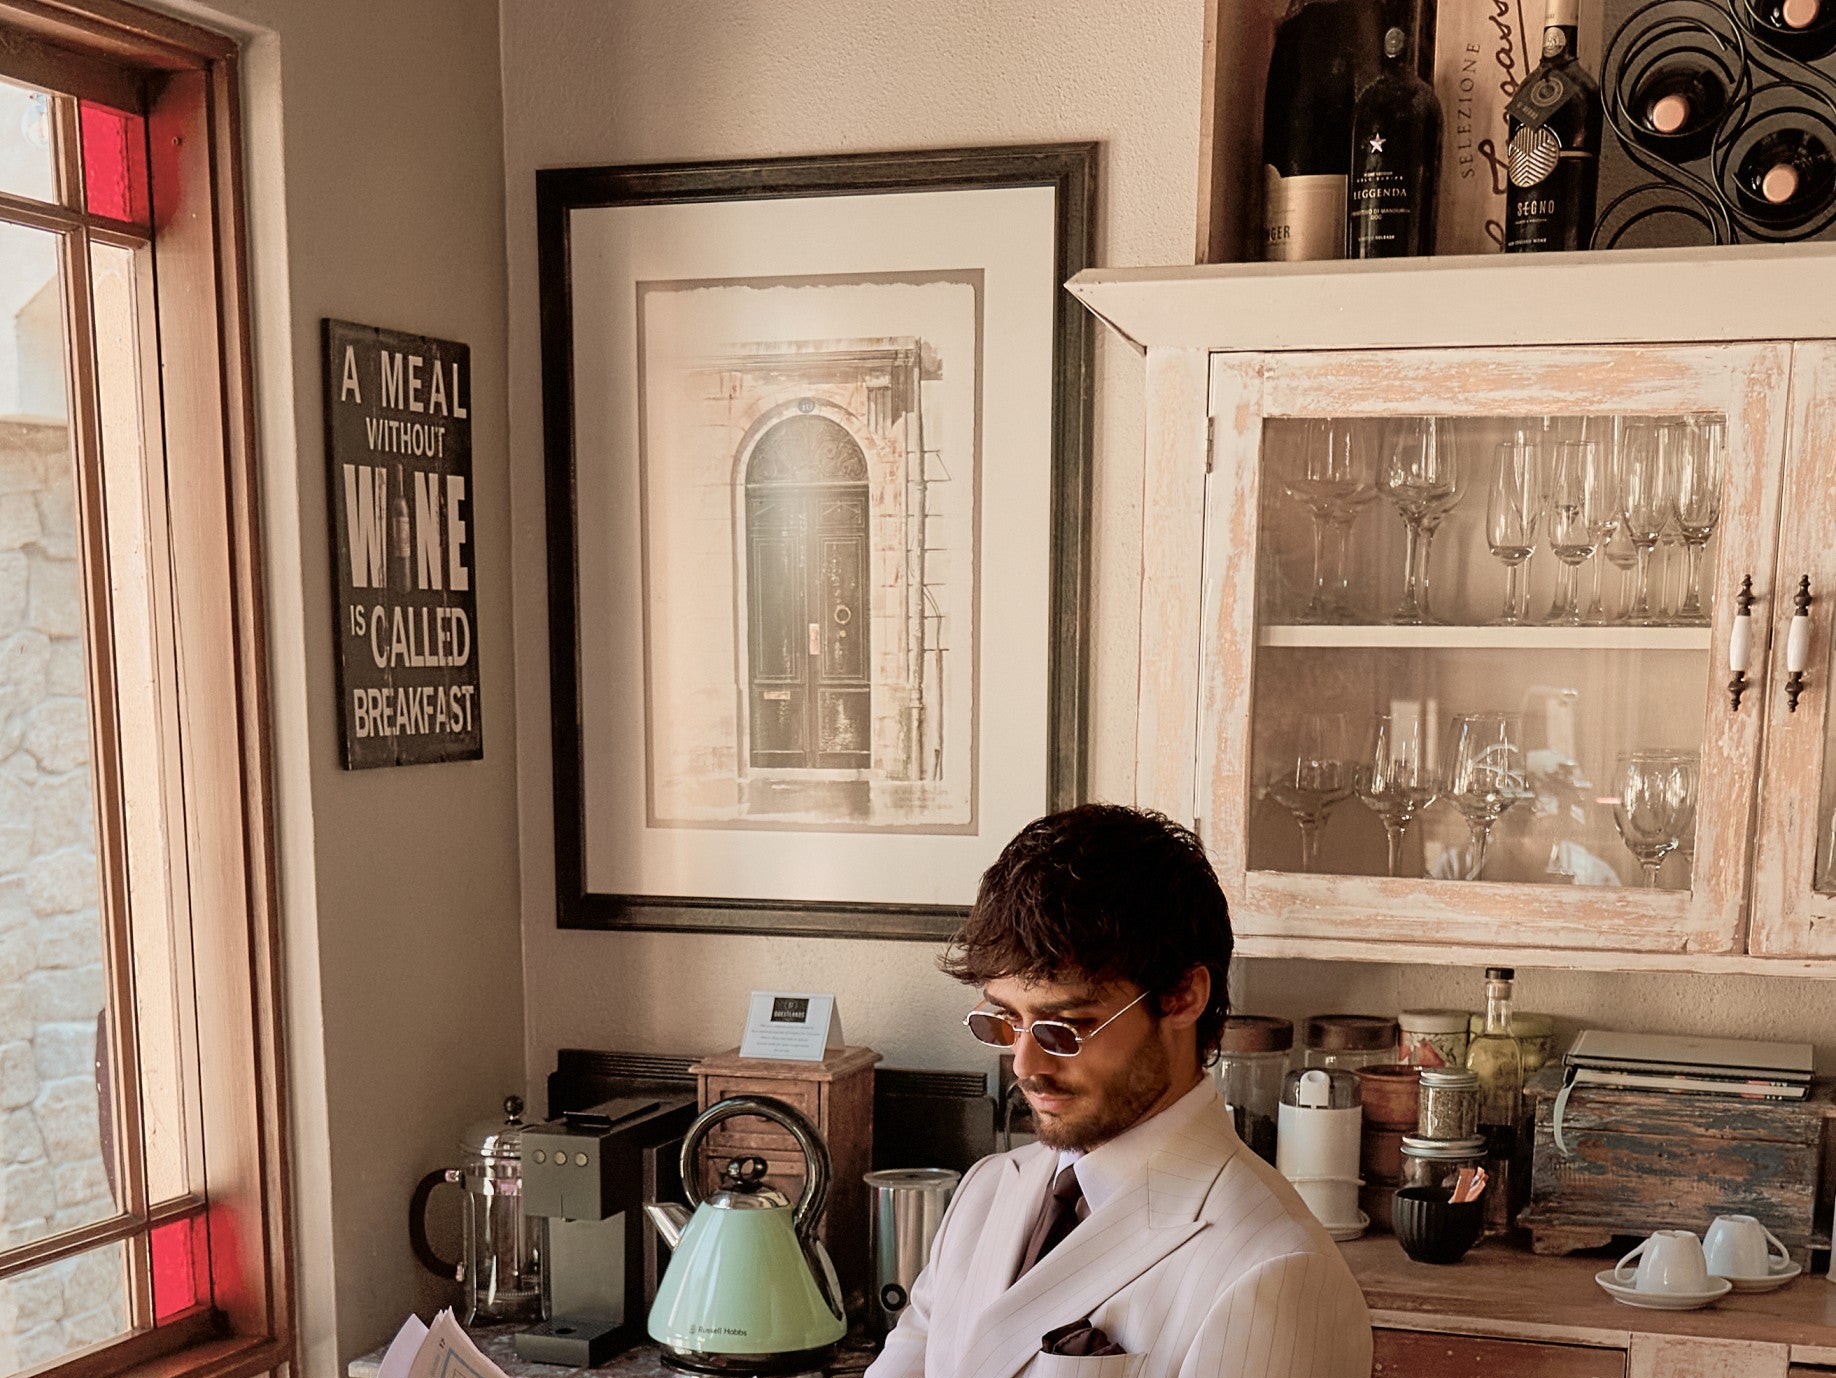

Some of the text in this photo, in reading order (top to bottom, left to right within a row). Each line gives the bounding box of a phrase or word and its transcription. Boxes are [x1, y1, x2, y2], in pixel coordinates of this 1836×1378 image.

[1457, 42, 1481, 179] SELEZIONE
[1353, 188, 1407, 200] LEGGENDA
[1517, 199, 1555, 217] SEGNO
[341, 345, 467, 419] A MEAL
[366, 416, 446, 458] WITHOUT
[350, 604, 471, 669] IS CALLED
[353, 685, 475, 738] BREAKFAST
[697, 1325, 748, 1337] Russell Hobbs
